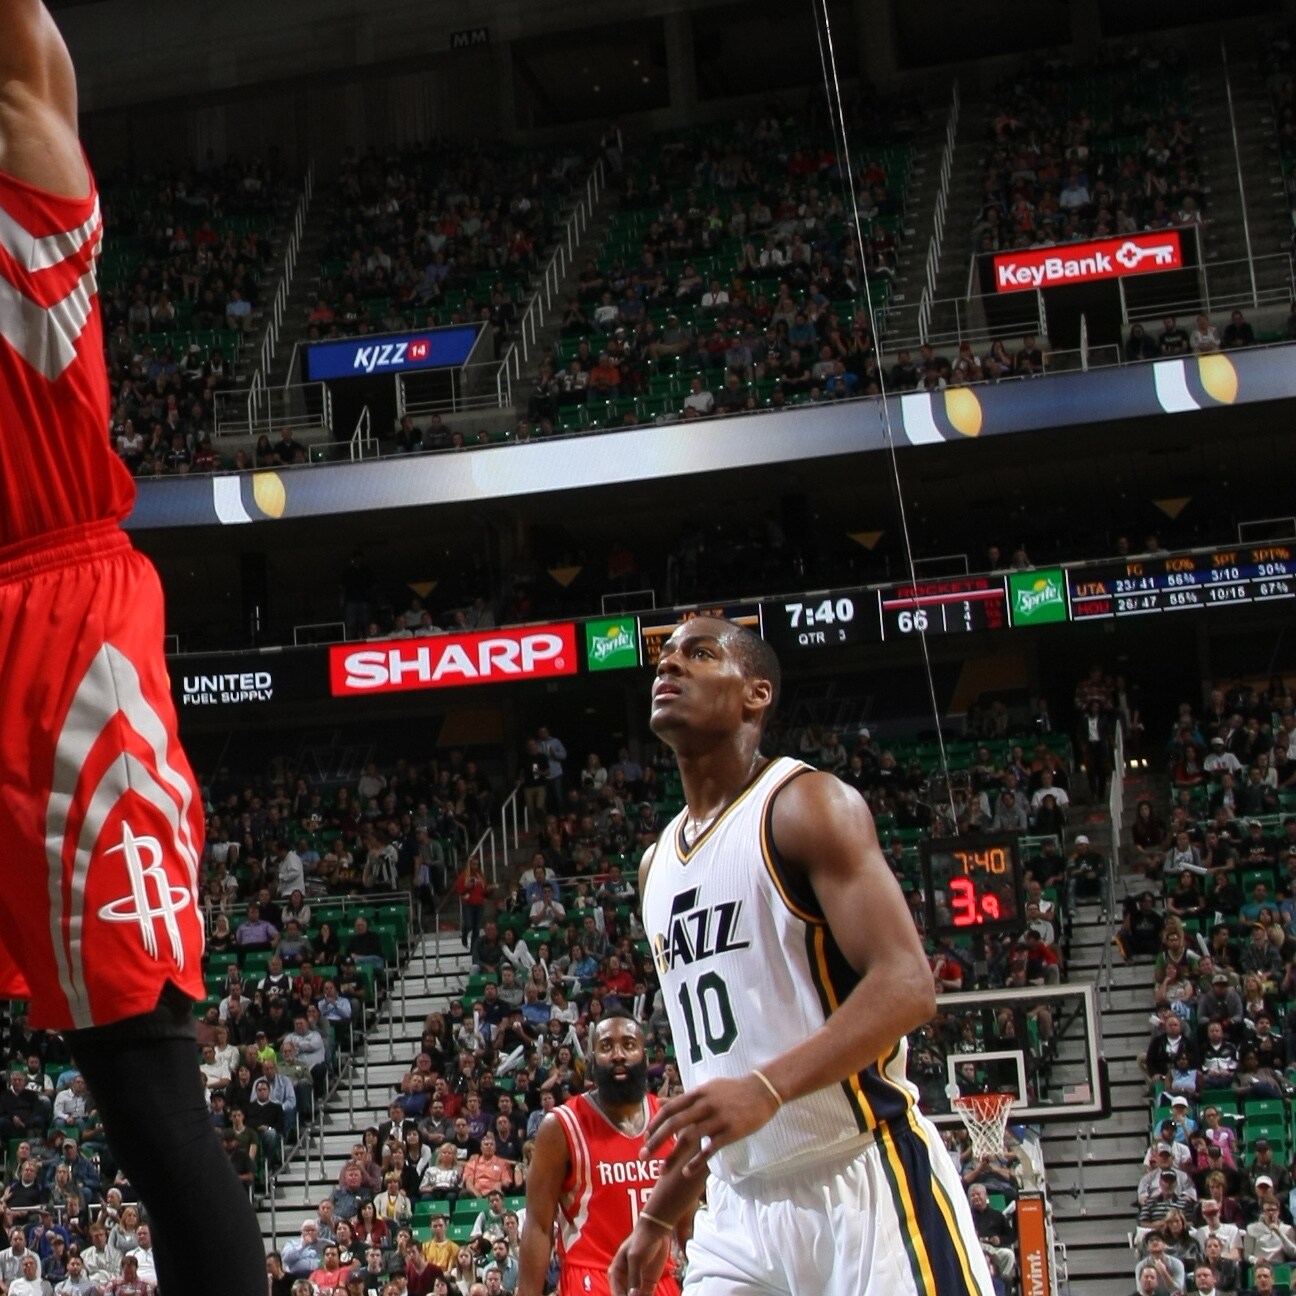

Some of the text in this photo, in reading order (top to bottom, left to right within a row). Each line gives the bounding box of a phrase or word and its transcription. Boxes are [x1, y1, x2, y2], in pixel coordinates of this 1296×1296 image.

[998, 252, 1113, 286] KeyBank
[354, 342, 426, 373] KJZZ 14
[898, 577, 988, 597] ROCKETS
[1076, 582, 1106, 597] UTA
[1211, 567, 1239, 581] 3/10
[785, 598, 854, 627] 7:40
[1020, 585, 1058, 612] Sprite
[897, 609, 928, 633] 66
[593, 633, 630, 658] Sprite
[798, 631, 826, 645] QTR
[344, 633, 563, 689] SHARP
[183, 672, 271, 693] UNITED
[183, 689, 273, 705] FUEL SUPPLY
[953, 848, 1006, 874] 7:40
[950, 878, 999, 926] 3.9
[654, 884, 751, 975] JAZZ
[678, 970, 739, 1065] 10
